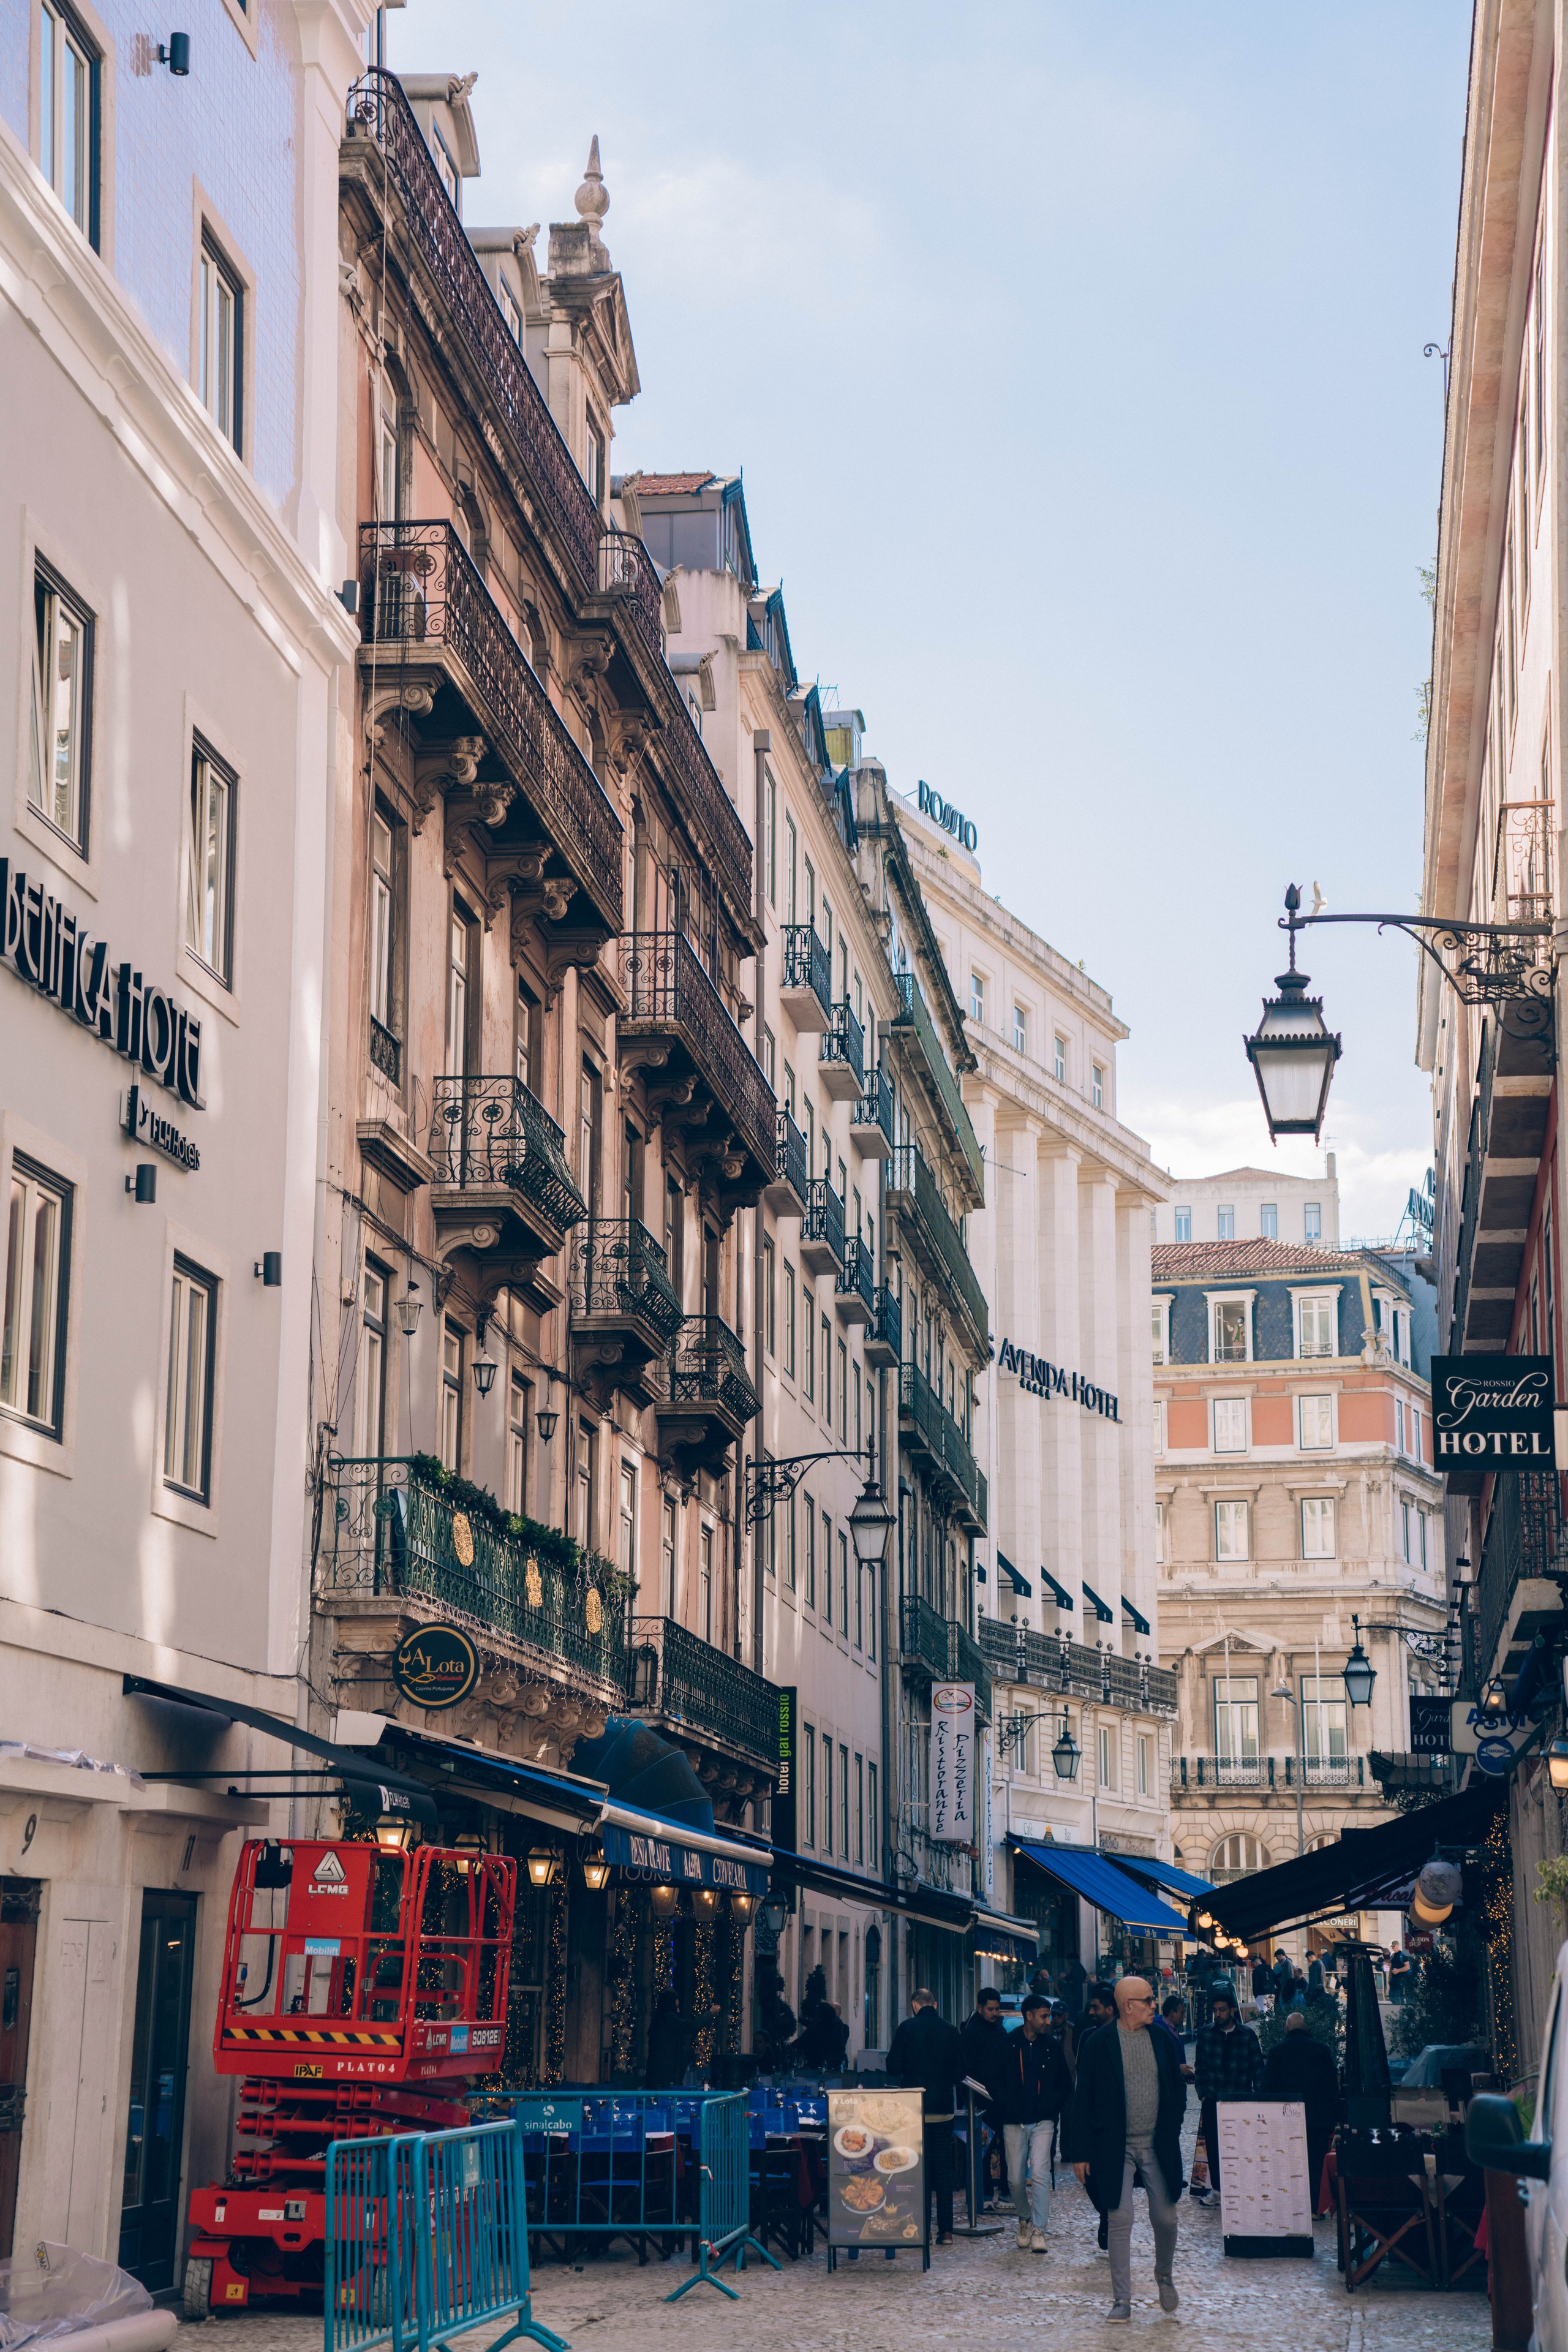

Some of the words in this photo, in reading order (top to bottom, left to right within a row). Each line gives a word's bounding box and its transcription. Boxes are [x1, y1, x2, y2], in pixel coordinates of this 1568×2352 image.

[918, 780, 978, 851] ROSSIO
[0, 857, 115, 1040] BENFICA
[117, 962, 206, 1110] HOTEL
[172, 1127, 200, 1170] Hotels
[1408, 1188, 1434, 1233] AVEN
[998, 1338, 1069, 1397] AVENIDA
[1072, 1372, 1123, 1424] HOTEL
[1436, 1372, 1548, 1428] Garden
[1438, 1432, 1551, 1455] HOTEL
[411, 1647, 426, 1665] A
[424, 1656, 464, 1673] Lota
[780, 1694, 790, 1733] rossio
[1466, 1708, 1526, 1727] AM
[779, 1736, 792, 1757] gat
[1414, 1734, 1450, 1746] HOT
[776, 1762, 790, 1794] hotel
[935, 1721, 949, 1833] Ristorante
[952, 1733, 969, 1822] Pizzeria
[21, 1814, 37, 1855] 9
[1023, 1822, 1033, 1836] Café
[182, 1834, 197, 1871] 11
[1311, 1917, 1357, 1927] LCONERI
[305, 1945, 339, 1955] Mobilift
[450, 2034, 468, 2051] Mobilift
[295, 2062, 322, 2077] IPAF
[525, 2119, 572, 2130] sinalcabo
